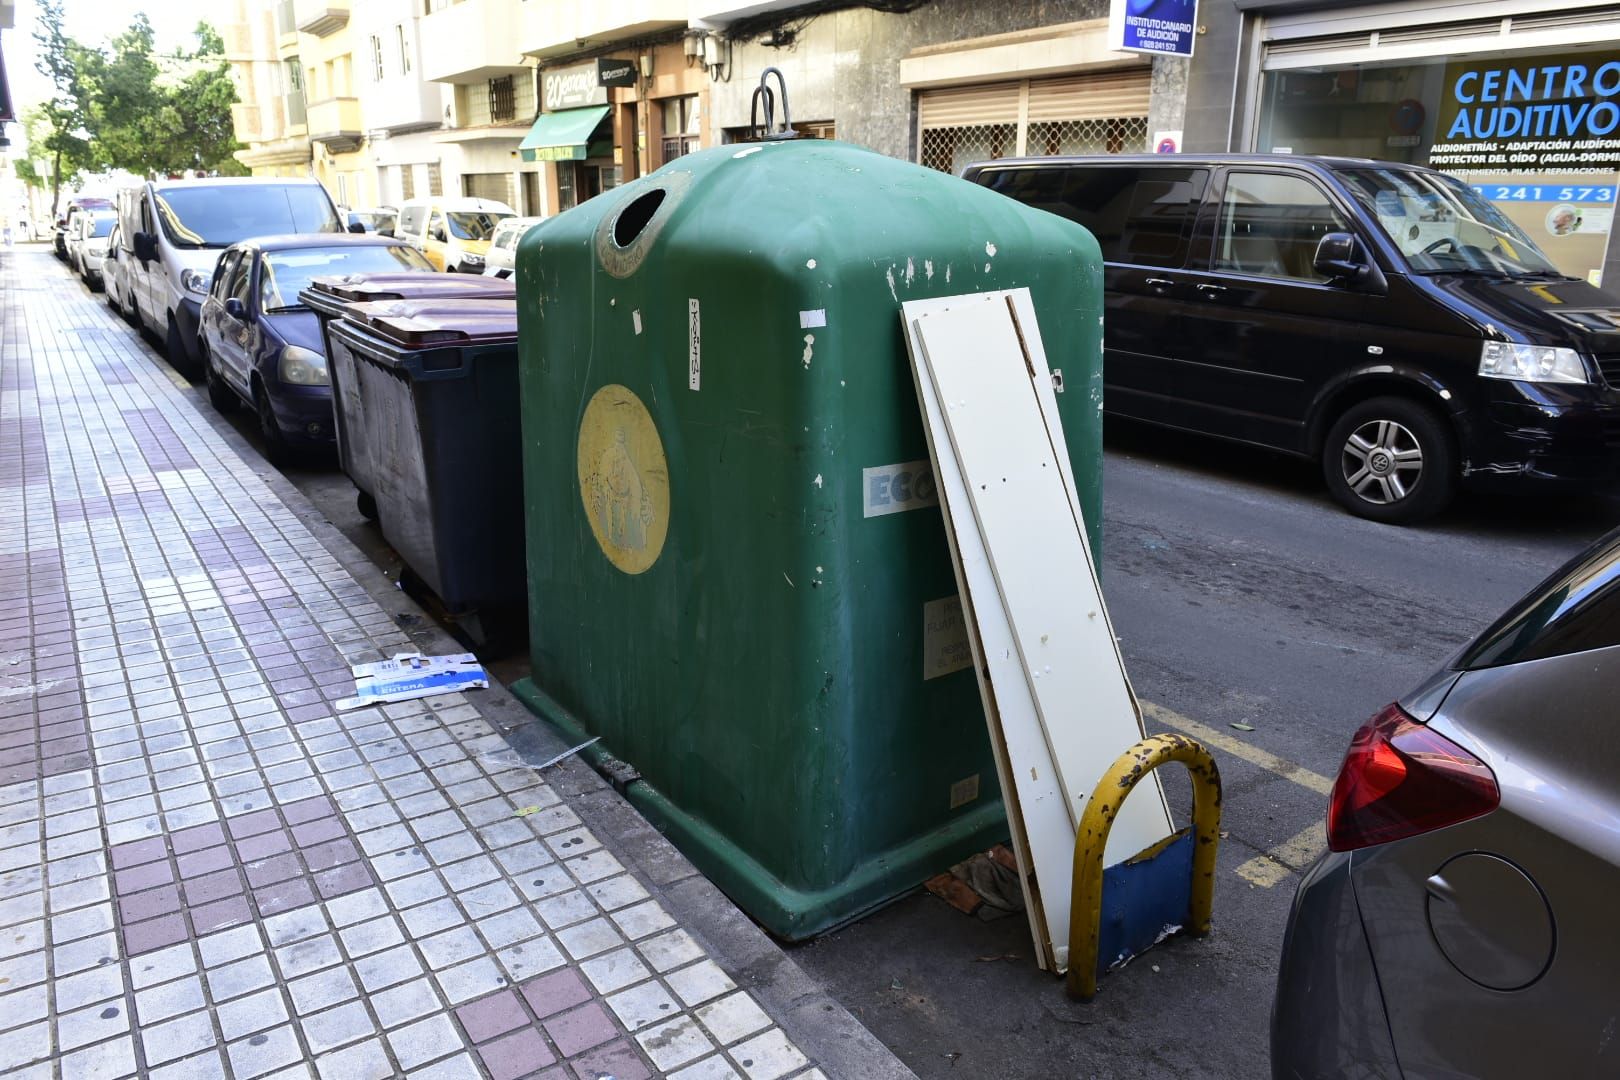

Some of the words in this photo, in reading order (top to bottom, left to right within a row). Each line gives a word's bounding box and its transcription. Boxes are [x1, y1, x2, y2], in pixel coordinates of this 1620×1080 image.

[1126, 16, 1160, 29] INSTITUTO
[1161, 20, 1191, 33] CANARIO
[1137, 28, 1146, 37] DE
[1147, 29, 1179, 41] AUDICIÓN
[1455, 61, 1620, 103] CENTRO
[1446, 102, 1620, 139] AUDITIVO
[1430, 141, 1497, 153] AUDIOMETRÍAS
[1505, 138, 1571, 151] ADAPTACIÓN
[1429, 154, 1486, 164] PROTECTOR
[1488, 154, 1507, 163] DEL
[1509, 151, 1537, 163] OÍDO
[1510, 167, 1535, 176] PILAS
[1536, 167, 1544, 176] Y
[1545, 166, 1615, 176] REPARACIONES
[1496, 187, 1542, 200] 241
[1558, 187, 1612, 201] 573
